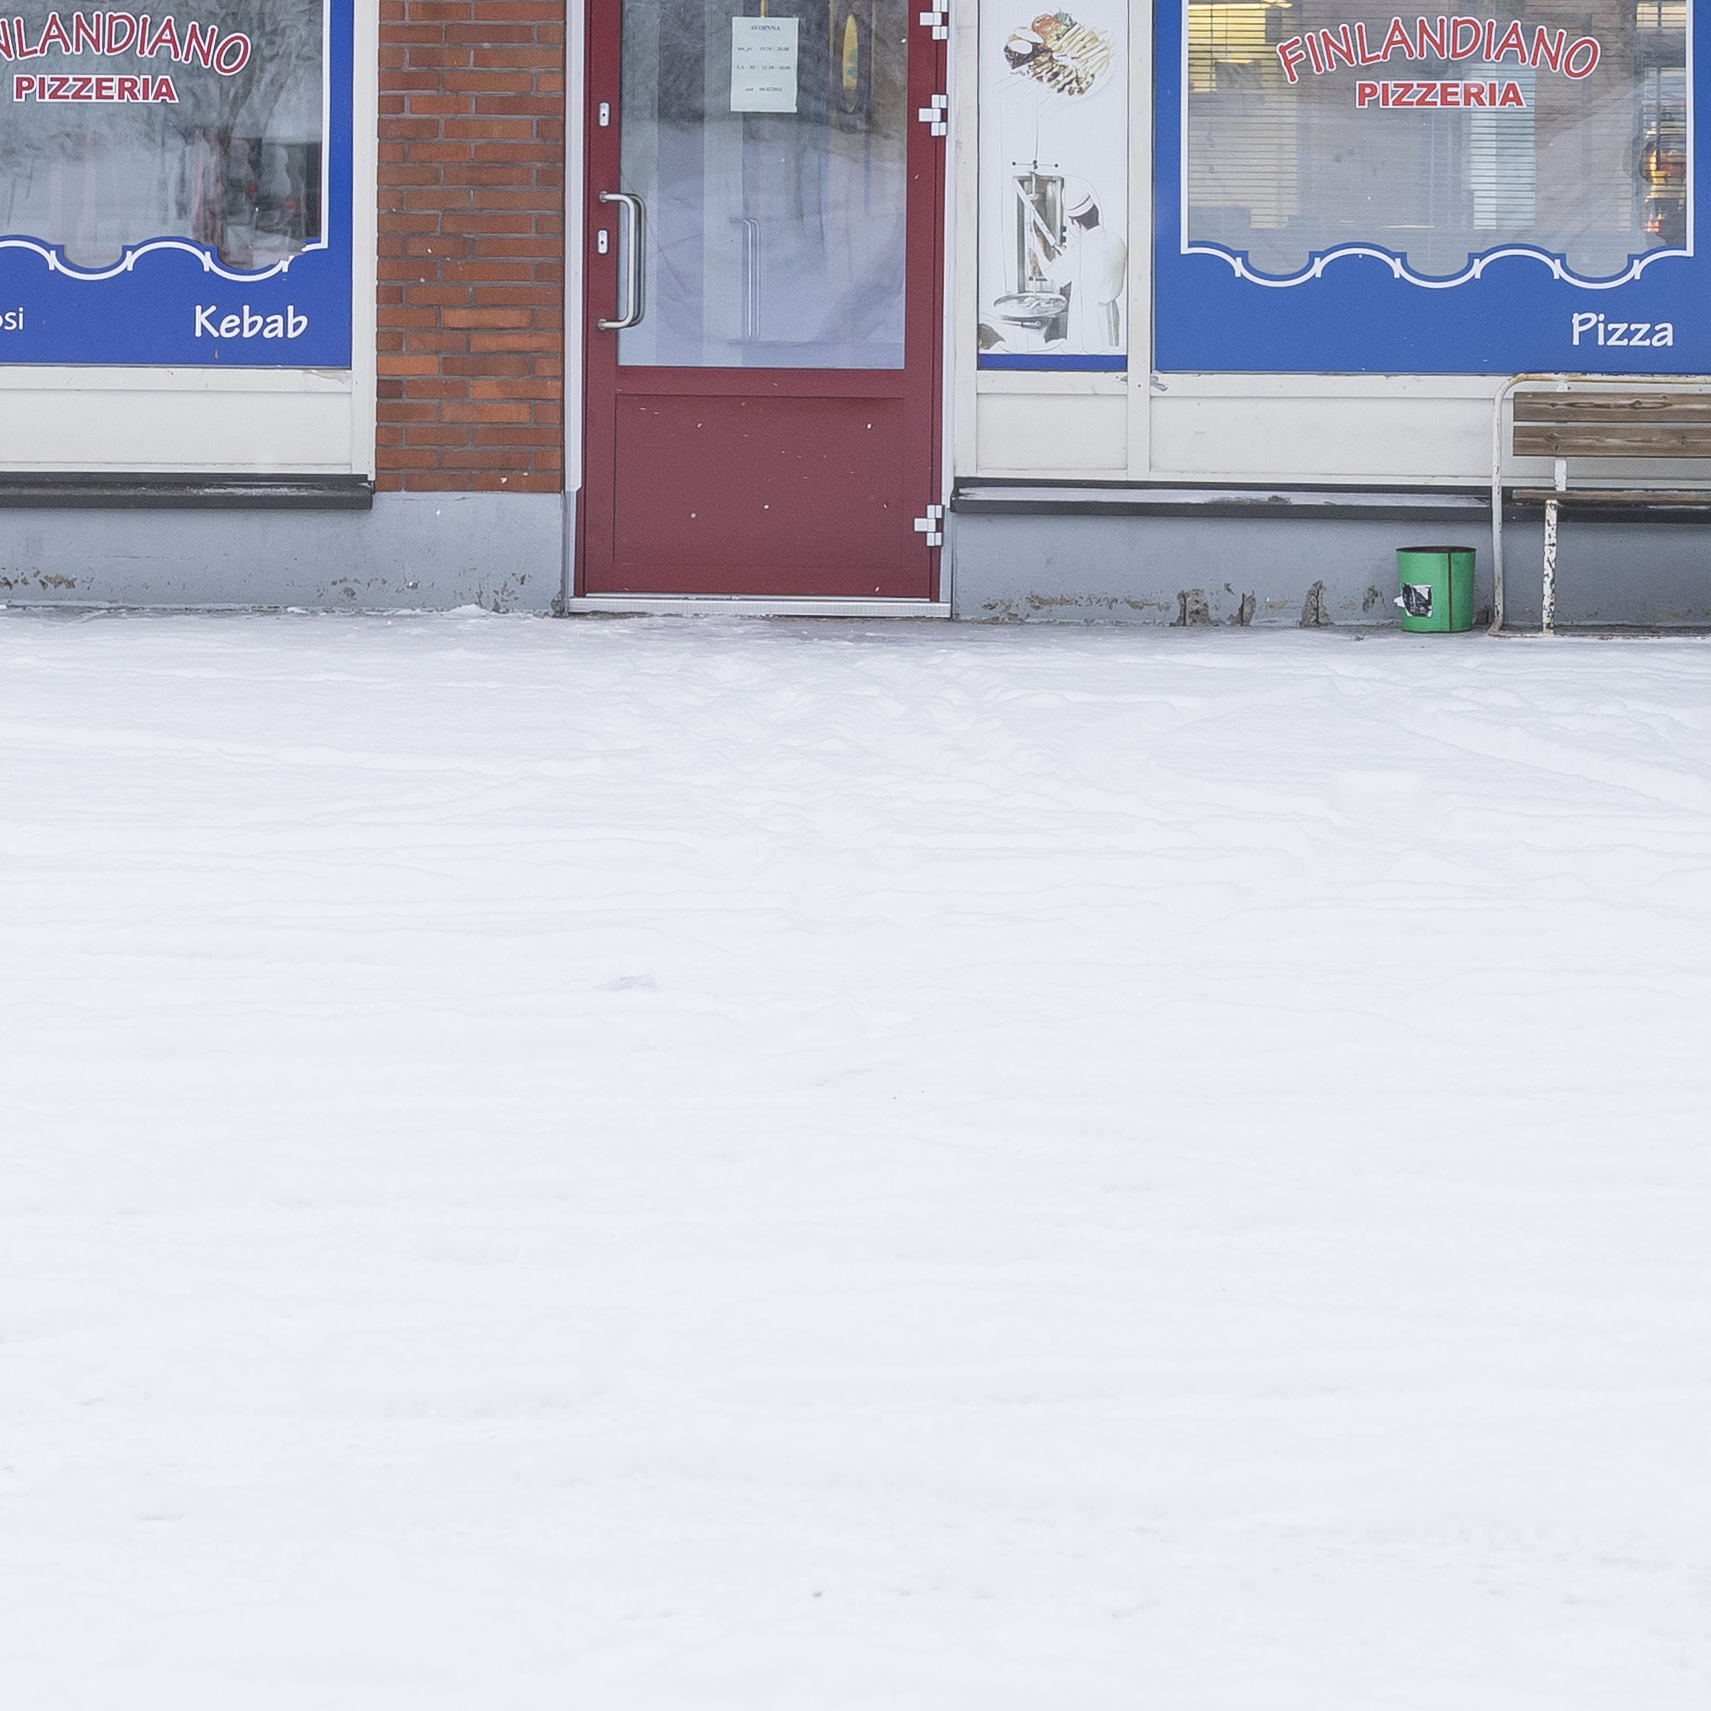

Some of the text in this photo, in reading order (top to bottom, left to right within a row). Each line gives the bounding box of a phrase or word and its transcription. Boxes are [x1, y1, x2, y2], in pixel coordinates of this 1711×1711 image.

[1275, 16, 1601, 84] FINLANDIANO
[14, 75, 179, 103] PIZZERIA
[1356, 81, 1525, 109] PIZZERIA
[194, 304, 308, 339] Kebab
[1572, 312, 1674, 348] Pizza
